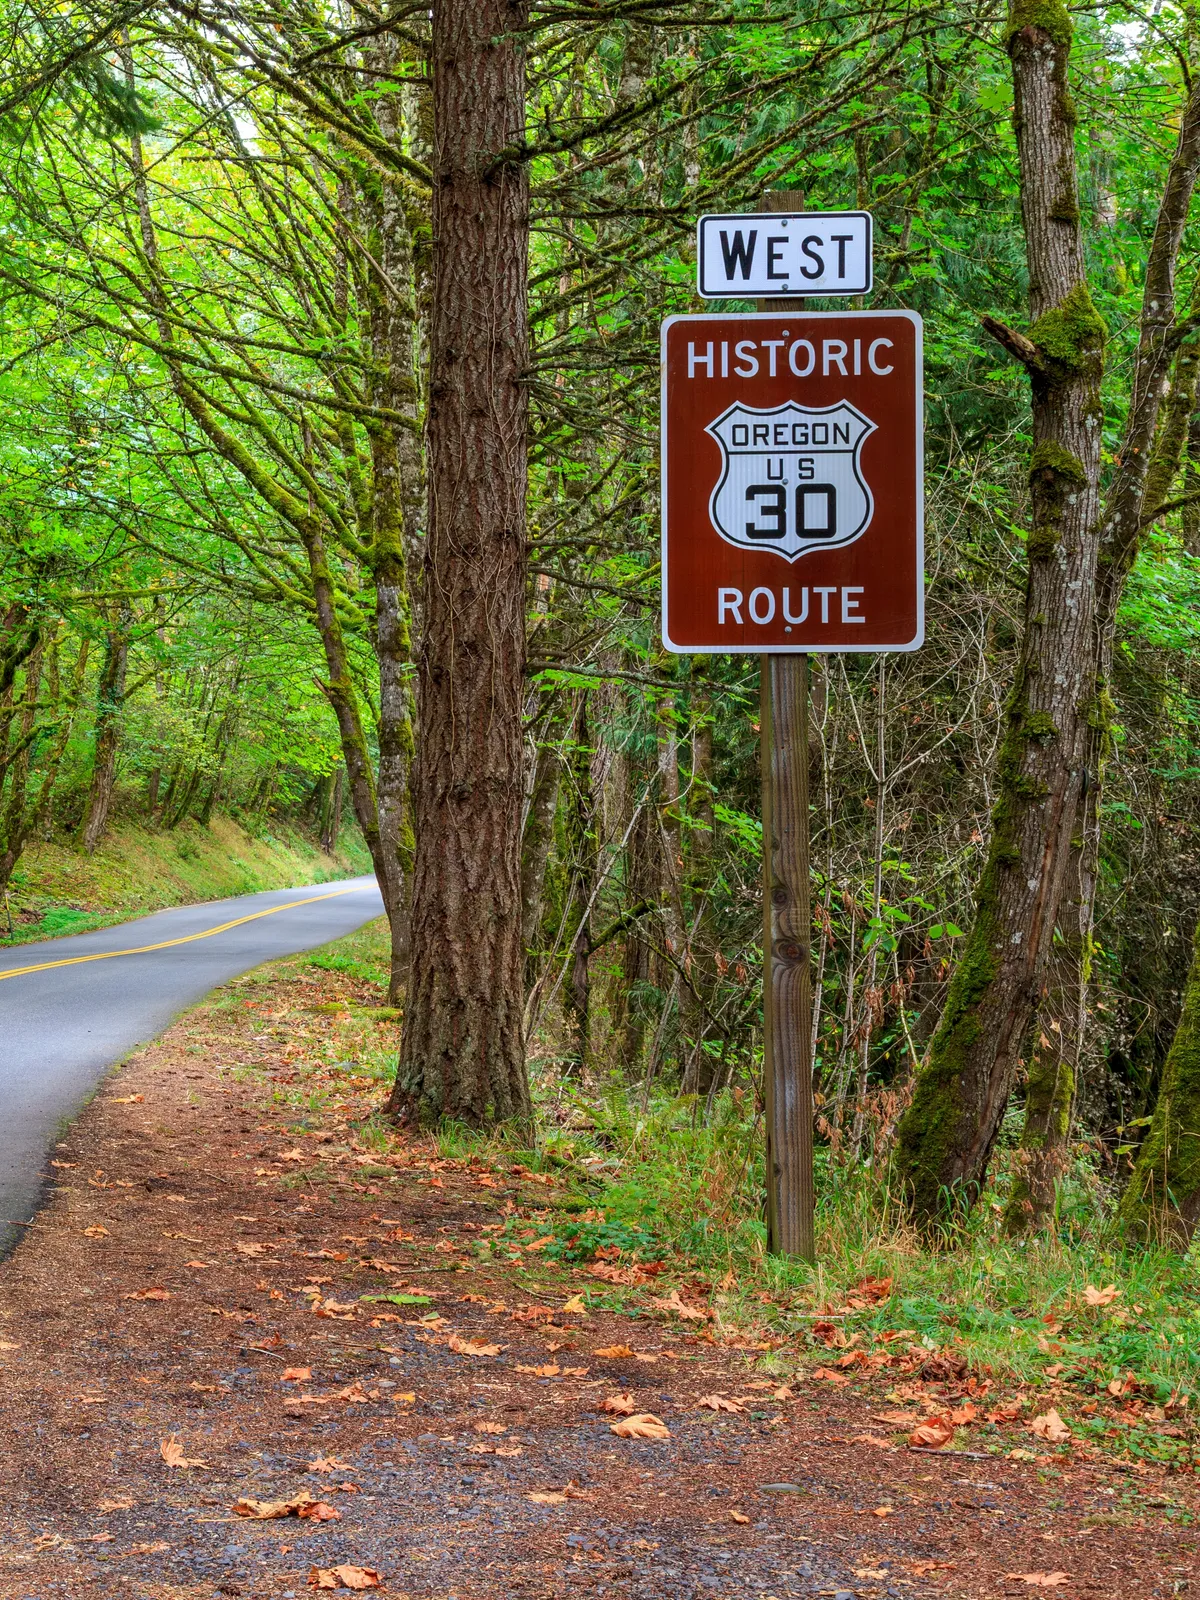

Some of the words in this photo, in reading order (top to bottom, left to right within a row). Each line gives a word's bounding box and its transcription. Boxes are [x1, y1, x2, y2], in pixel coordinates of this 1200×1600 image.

[719, 229, 854, 281] WEST
[687, 337, 895, 379] HISTORIC
[732, 422, 850, 447] OREGON
[745, 483, 837, 539] 30
[717, 586, 866, 625] ROUTE
